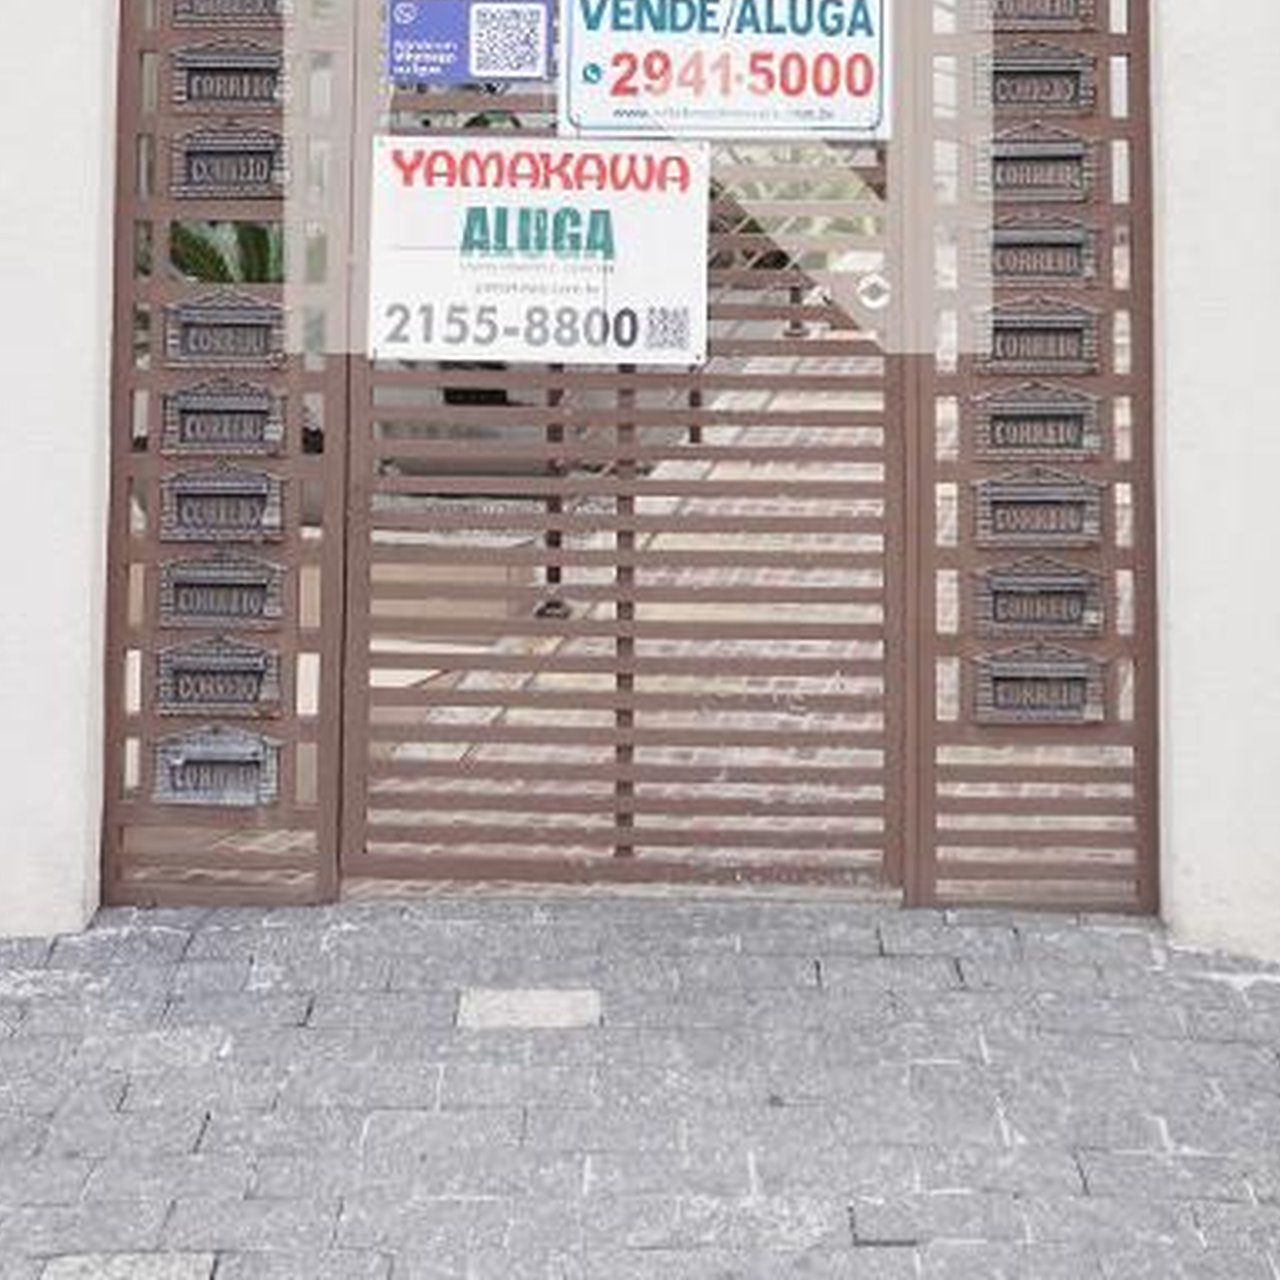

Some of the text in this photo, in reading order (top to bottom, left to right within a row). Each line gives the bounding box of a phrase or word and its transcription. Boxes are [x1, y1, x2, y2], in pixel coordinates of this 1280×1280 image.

[391, 149, 691, 192] YAMAKAWA
[460, 205, 615, 260] ALUGA
[384, 303, 639, 348] 2155-8800
